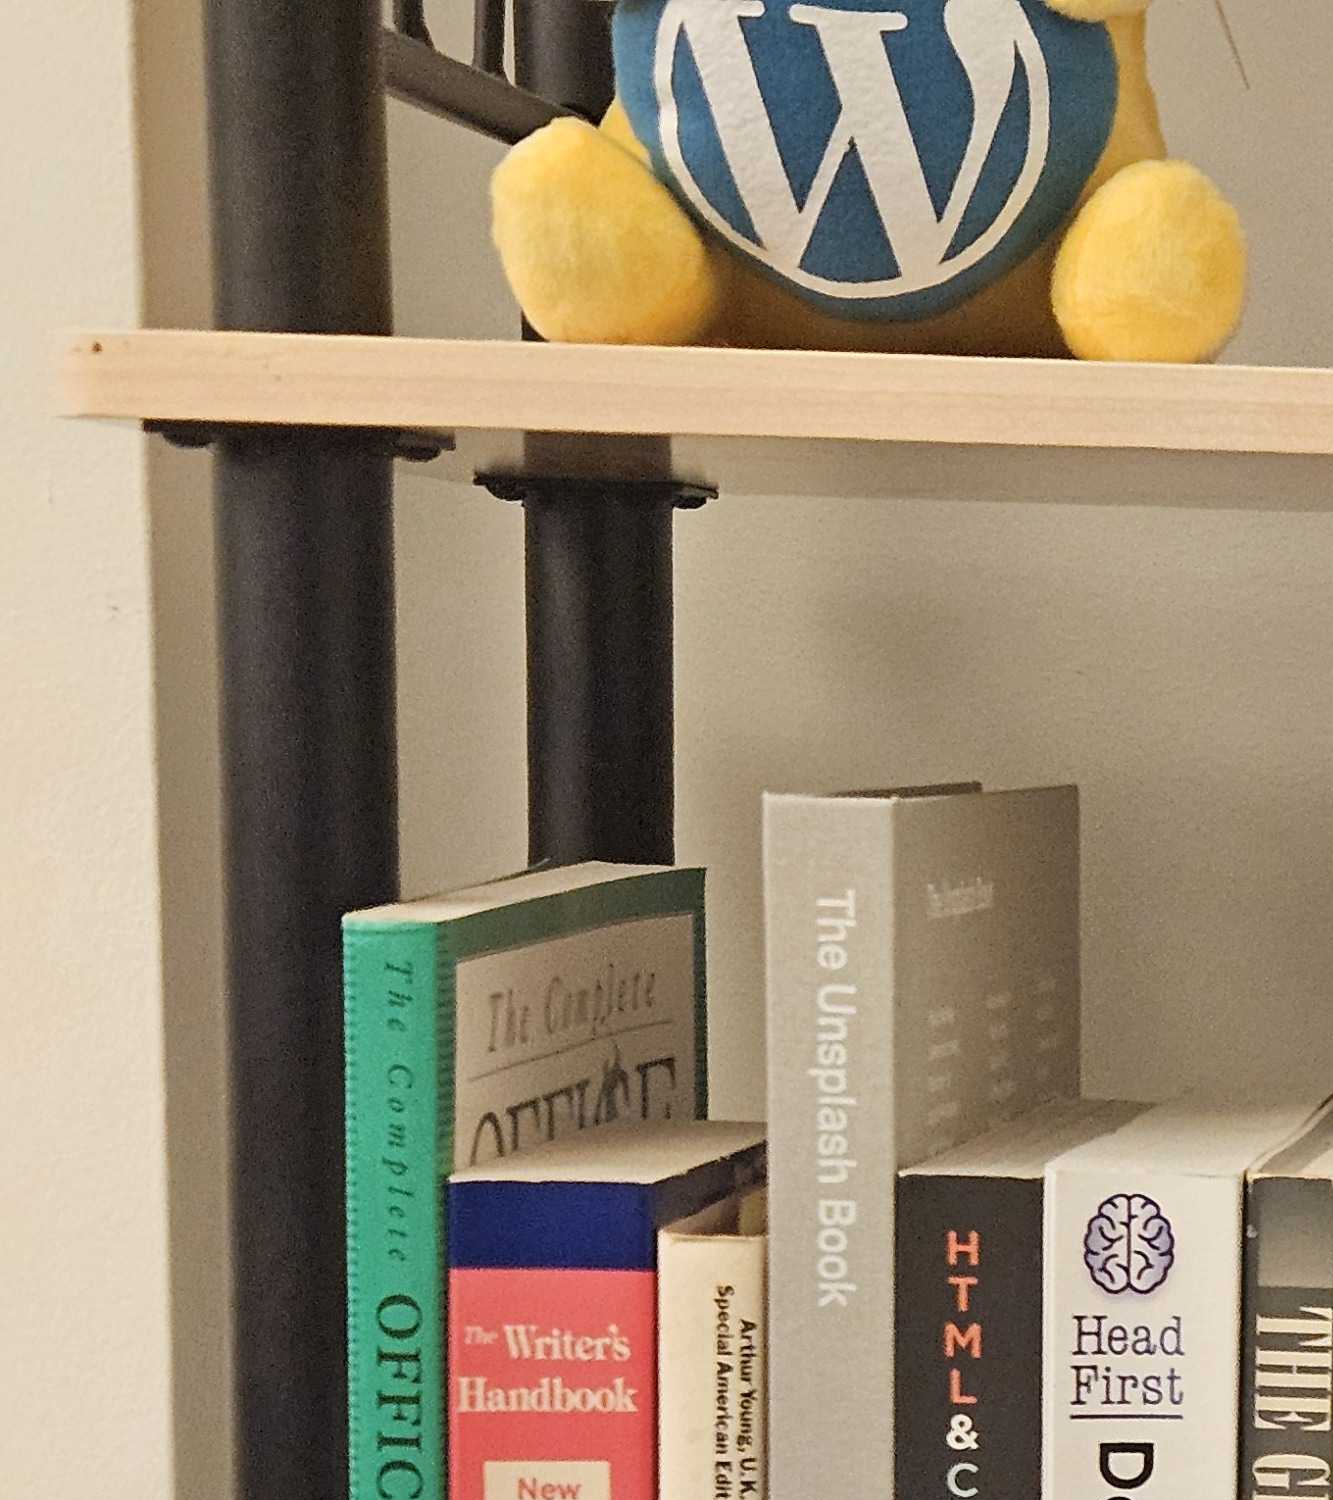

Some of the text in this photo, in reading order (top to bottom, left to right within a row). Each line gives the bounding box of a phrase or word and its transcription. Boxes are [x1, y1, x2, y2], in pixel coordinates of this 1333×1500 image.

[807, 889, 858, 1306] The Unsplash Book
[464, 1324, 630, 1360] The Writer's
[1072, 1316, 1184, 1355] Head
[1071, 1365, 1183, 1405] First
[1254, 1307, 1333, 1431] THE
[458, 1377, 637, 1412] Handbook
[518, 1478, 581, 1500] New
